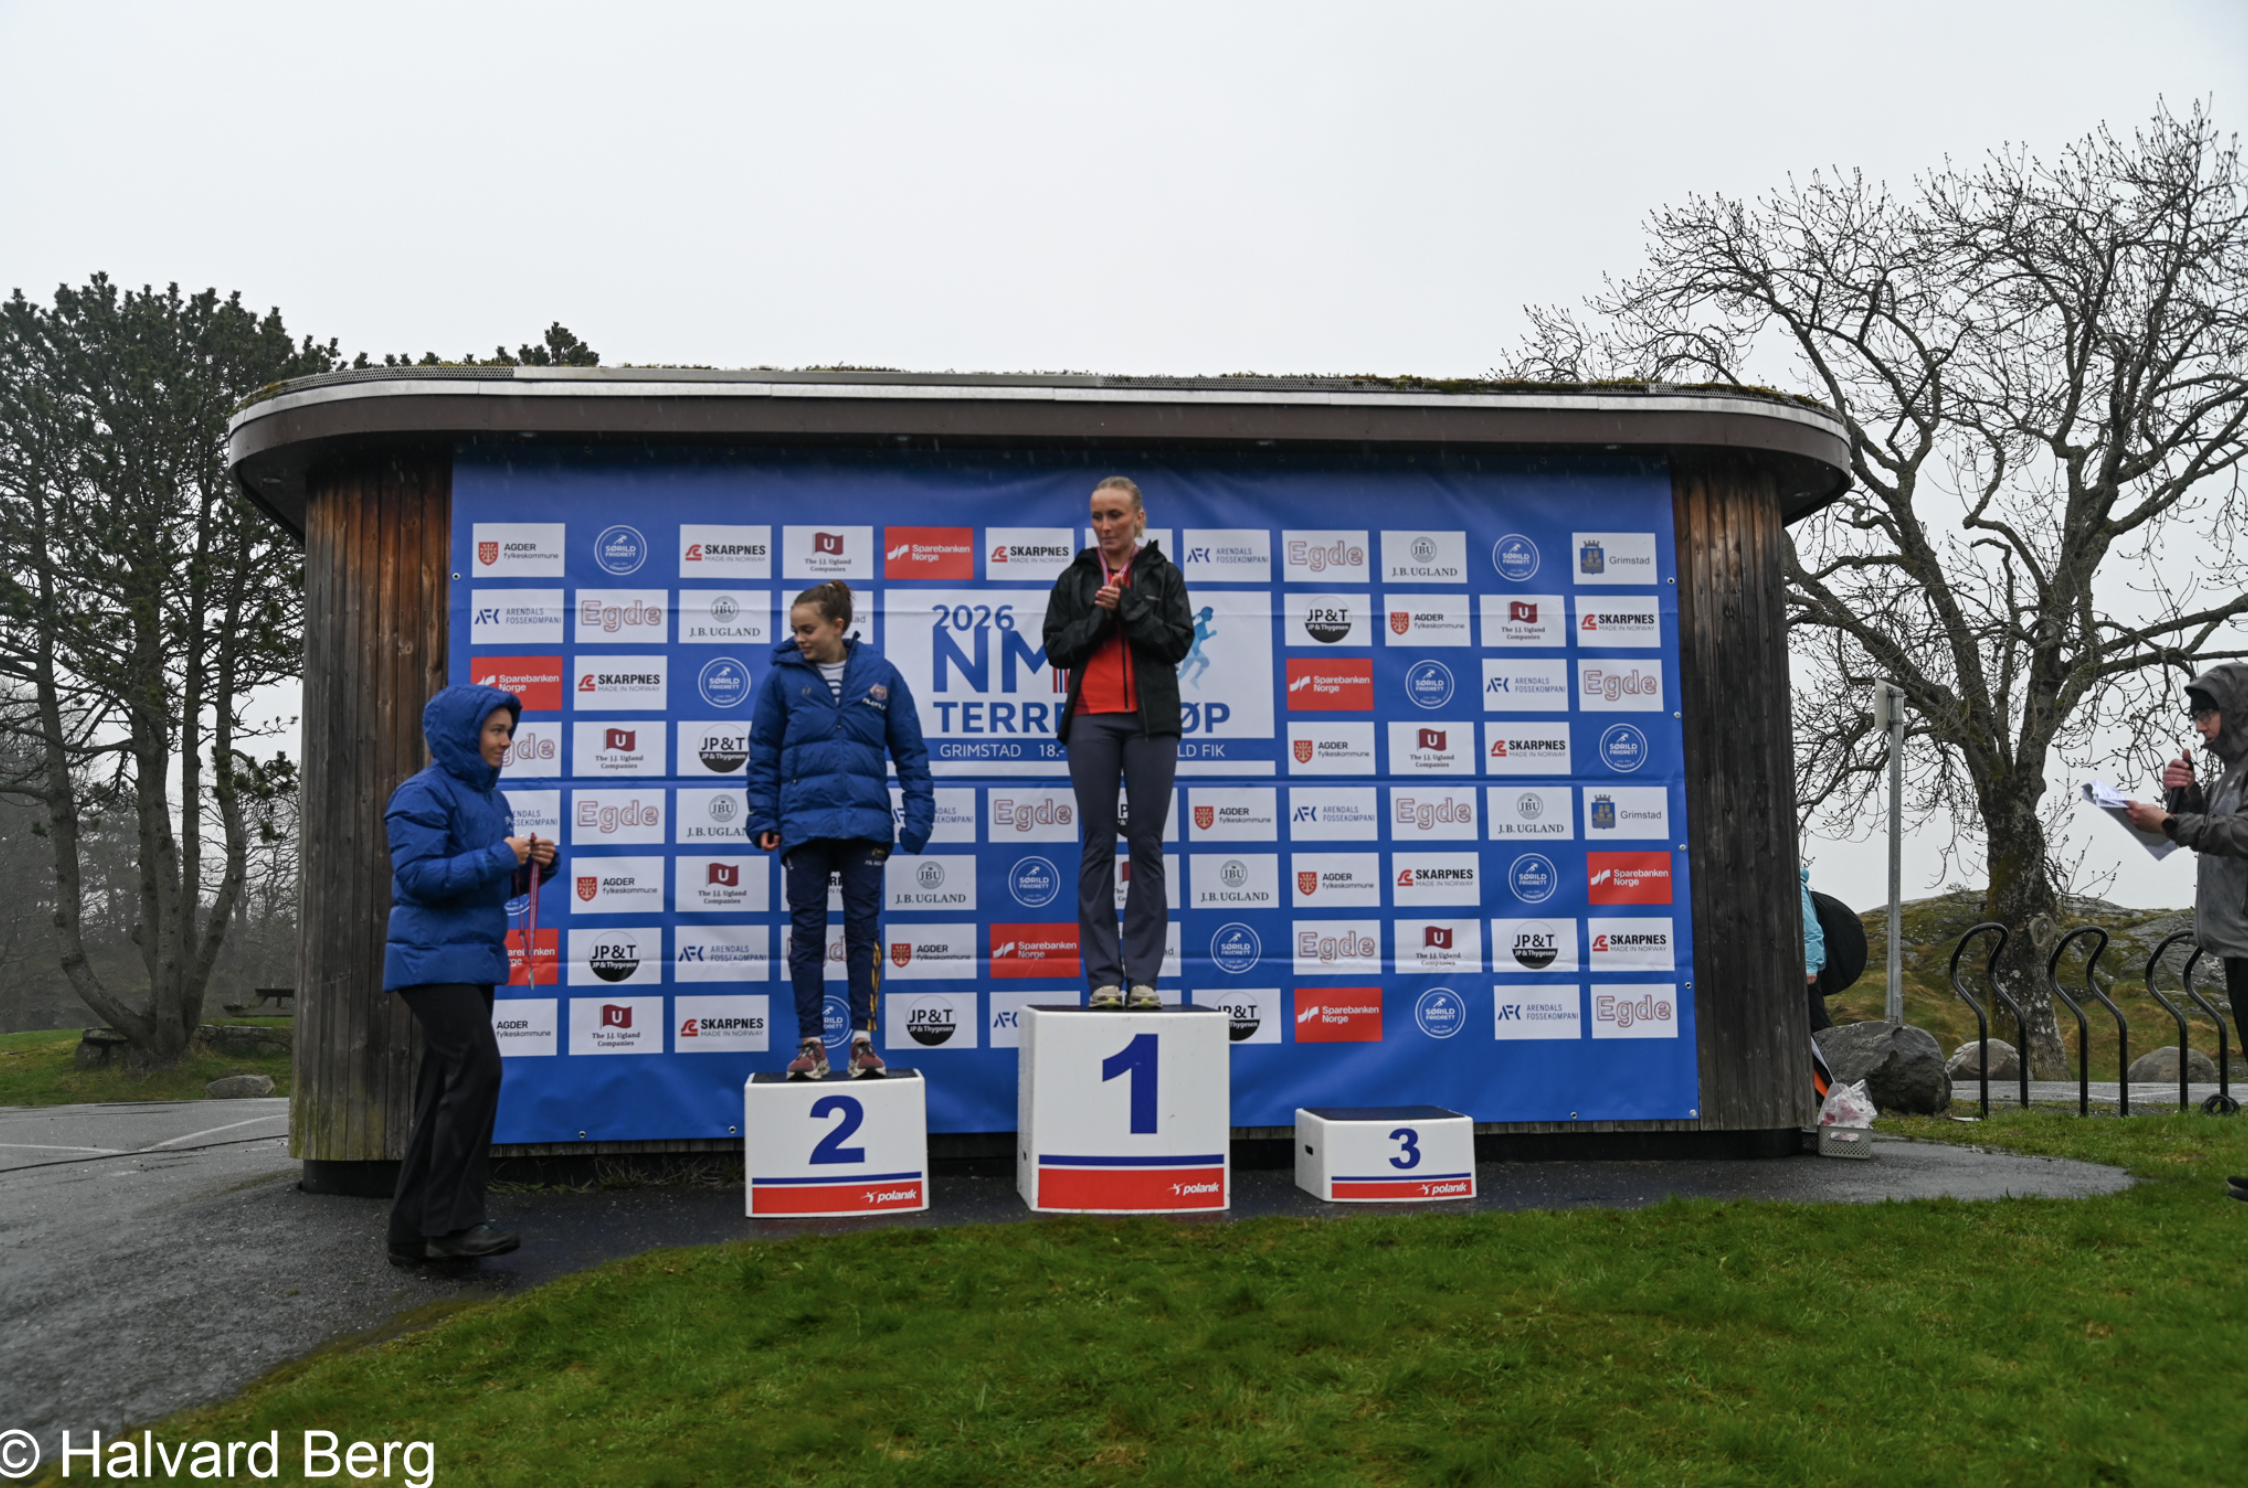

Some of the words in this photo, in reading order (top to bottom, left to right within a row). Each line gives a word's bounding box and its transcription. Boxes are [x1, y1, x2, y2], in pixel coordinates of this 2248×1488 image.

[504, 543, 536, 551] AGDER
[705, 544, 766, 555] SKARPNES
[912, 544, 970, 554] Sparebanken
[1010, 546, 1069, 556] SKARPNES
[1414, 546, 1434, 555] JBU
[912, 554, 939, 563] Norge
[1288, 540, 1363, 572] Egde
[1609, 556, 1650, 565] Grimstad
[828, 558, 852, 566] Ugland
[810, 565, 846, 573] Companies
[1410, 567, 1457, 578] UGLAND
[714, 606, 736, 615] JBU
[1307, 609, 1348, 622] JP&T
[581, 599, 662, 633] Egde
[932, 605, 1014, 631] 2026
[1598, 614, 1654, 624] SKARPNES
[709, 628, 760, 637] UGLAND
[933, 627, 1069, 693] NM
[499, 673, 559, 685] Sparebanken
[598, 674, 660, 684] SKARPNES
[1313, 676, 1370, 685] Sparebanken
[499, 684, 526, 693] Norge
[1313, 685, 1339, 694] Norge
[1584, 669, 1657, 702] Egde
[701, 737, 745, 750] JP&T
[1318, 742, 1348, 750] AGDER
[1509, 740, 1565, 750] SKARPNES
[940, 744, 1021, 758] GRIMSTAD
[1202, 744, 1225, 757] FIK
[600, 762, 637, 770] Companies
[712, 804, 734, 814] JBU
[1520, 802, 1540, 811] JBU
[512, 810, 540, 818] ENDALS
[577, 800, 659, 833] Egde
[993, 798, 1072, 832] Egde
[1219, 808, 1249, 816] AGDER
[1396, 797, 1471, 830] Egde
[1620, 810, 1662, 820] Grimstad
[1323, 814, 1375, 822] FOSSEKOMPANI
[708, 827, 747, 836] UGLA
[1516, 824, 1564, 834] UGLAND
[920, 871, 941, 880] JBU
[1224, 869, 1245, 879] JBU
[1322, 873, 1352, 881] AGDER
[1415, 869, 1473, 879] SKARPNES
[1614, 869, 1669, 879] Sparebanken
[603, 877, 635, 886] AGDER
[1614, 879, 1639, 888] Norge
[603, 887, 657, 895] fylkeskommune
[723, 890, 747, 898] Ugland
[915, 894, 966, 904] UGLAND
[1220, 892, 1269, 902] UGLAND
[1514, 934, 1555, 947] JP&T
[1610, 934, 1666, 945] SKARPNES
[711, 945, 749, 953] ARENDALS
[917, 945, 948, 953] AGDER
[1018, 941, 1077, 951] Sparebanken
[1298, 930, 1375, 965] Egde
[592, 945, 636, 959] JP&T
[1018, 951, 1045, 960] Norge
[710, 953, 767, 962] FOSSEKOMPANI
[1322, 1005, 1379, 1016] Sparebanken
[1596, 994, 1671, 1028] Egde
[909, 1009, 953, 1023] JP&T
[1322, 1015, 1348, 1025] Norge
[1527, 1012, 1579, 1020] FOSSEKOMPANI
[497, 1020, 528, 1029] AGDER
[701, 1018, 763, 1029] SKARPNES
[616, 1032, 641, 1040] Ugland
[597, 1040, 634, 1048] Companies
[1102, 1034, 1158, 1134] 1
[809, 1095, 865, 1164] 2
[1389, 1128, 1421, 1169] 3
[1183, 1182, 1219, 1195] polanik
[1432, 1182, 1467, 1195] polanik
[877, 1189, 916, 1203] polanik
